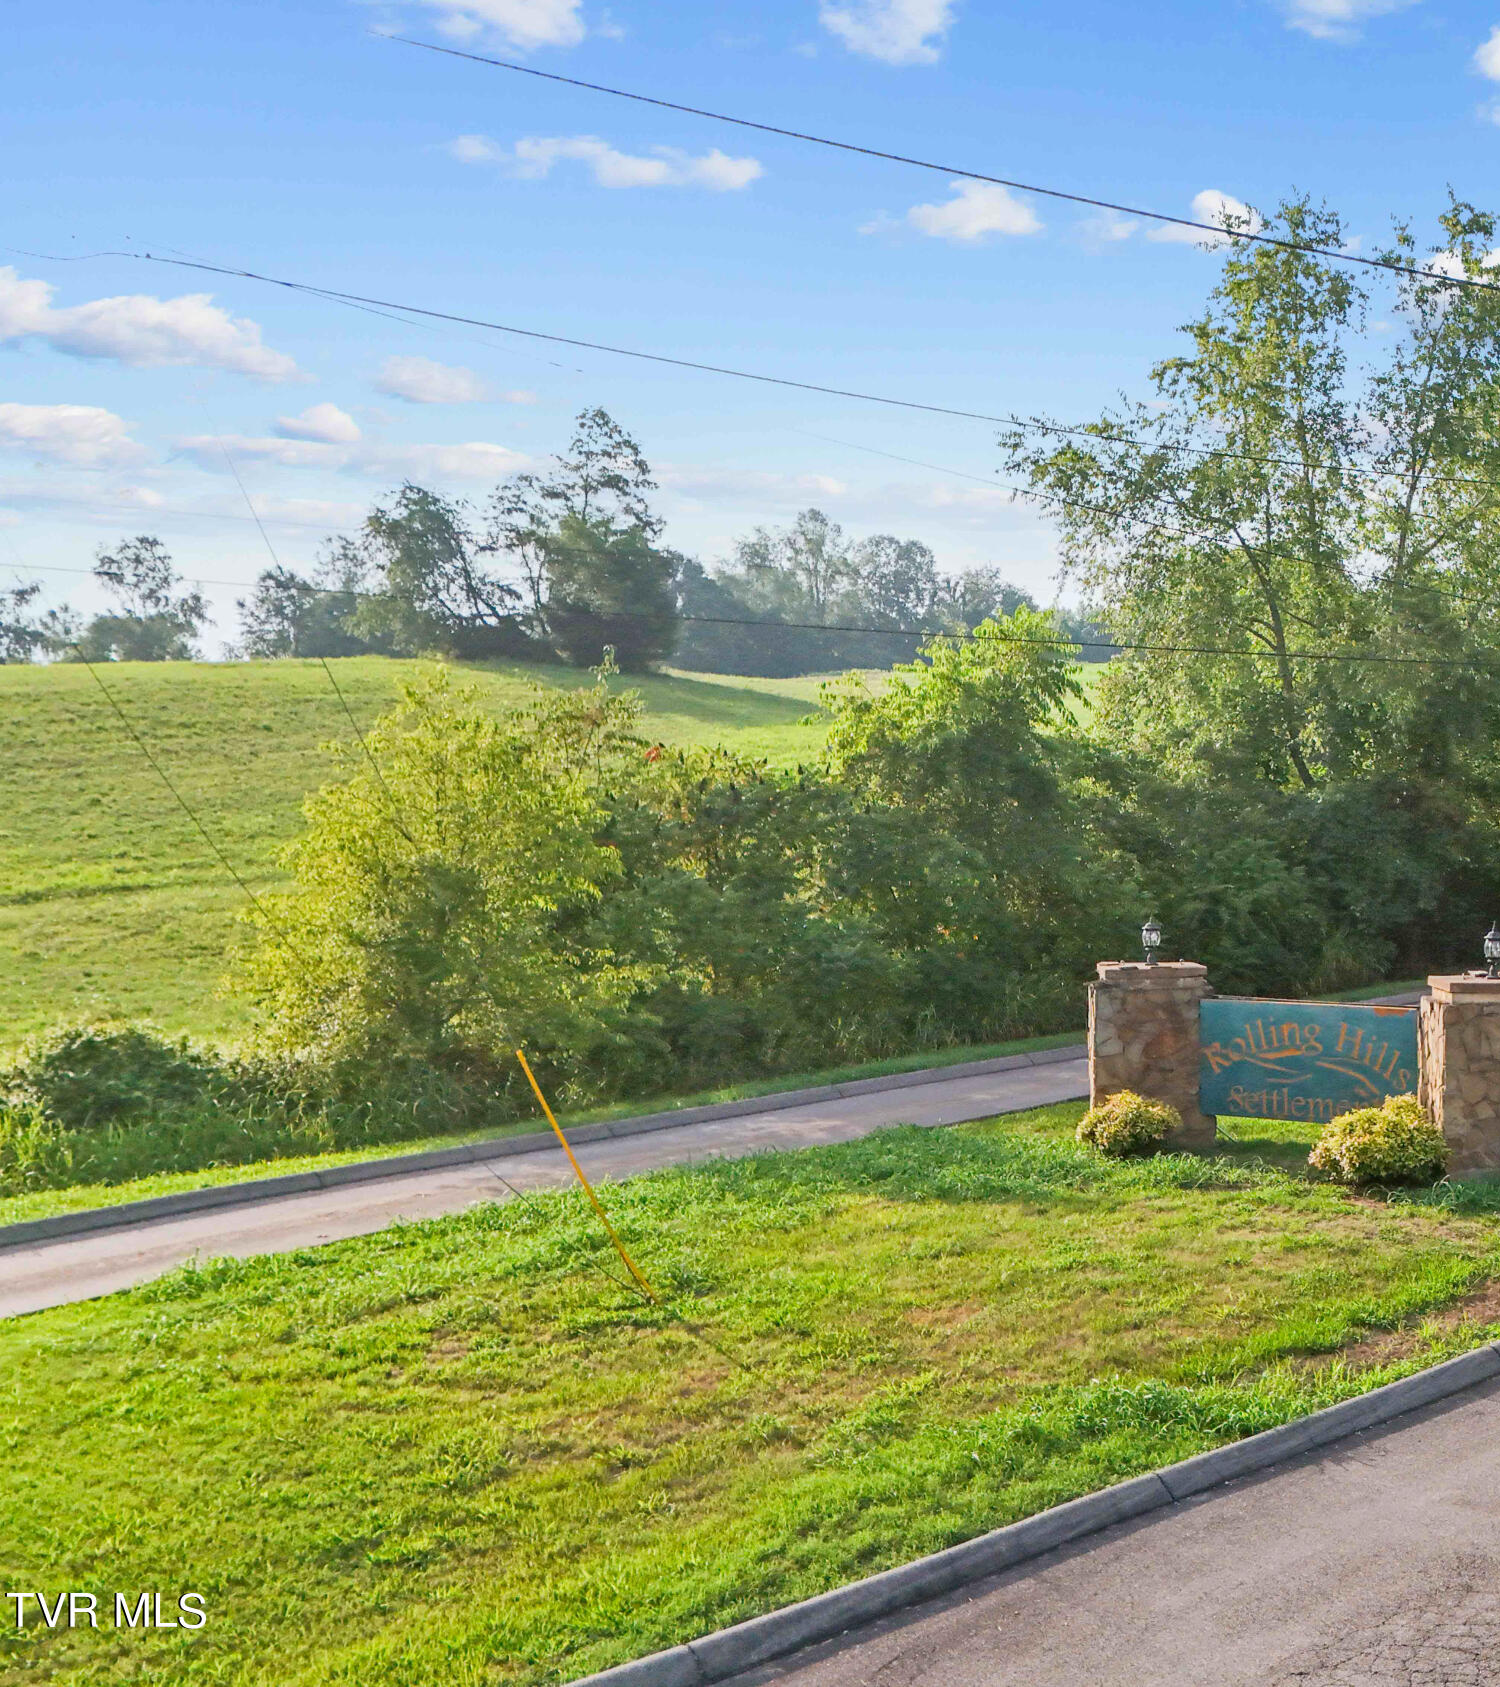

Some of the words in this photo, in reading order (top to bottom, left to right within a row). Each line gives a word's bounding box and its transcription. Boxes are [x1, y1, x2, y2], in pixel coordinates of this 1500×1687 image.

[1201, 1016, 1323, 1074] Rolling
[1335, 1021, 1411, 1091] Hills
[1226, 1085, 1384, 1122] Settleme
